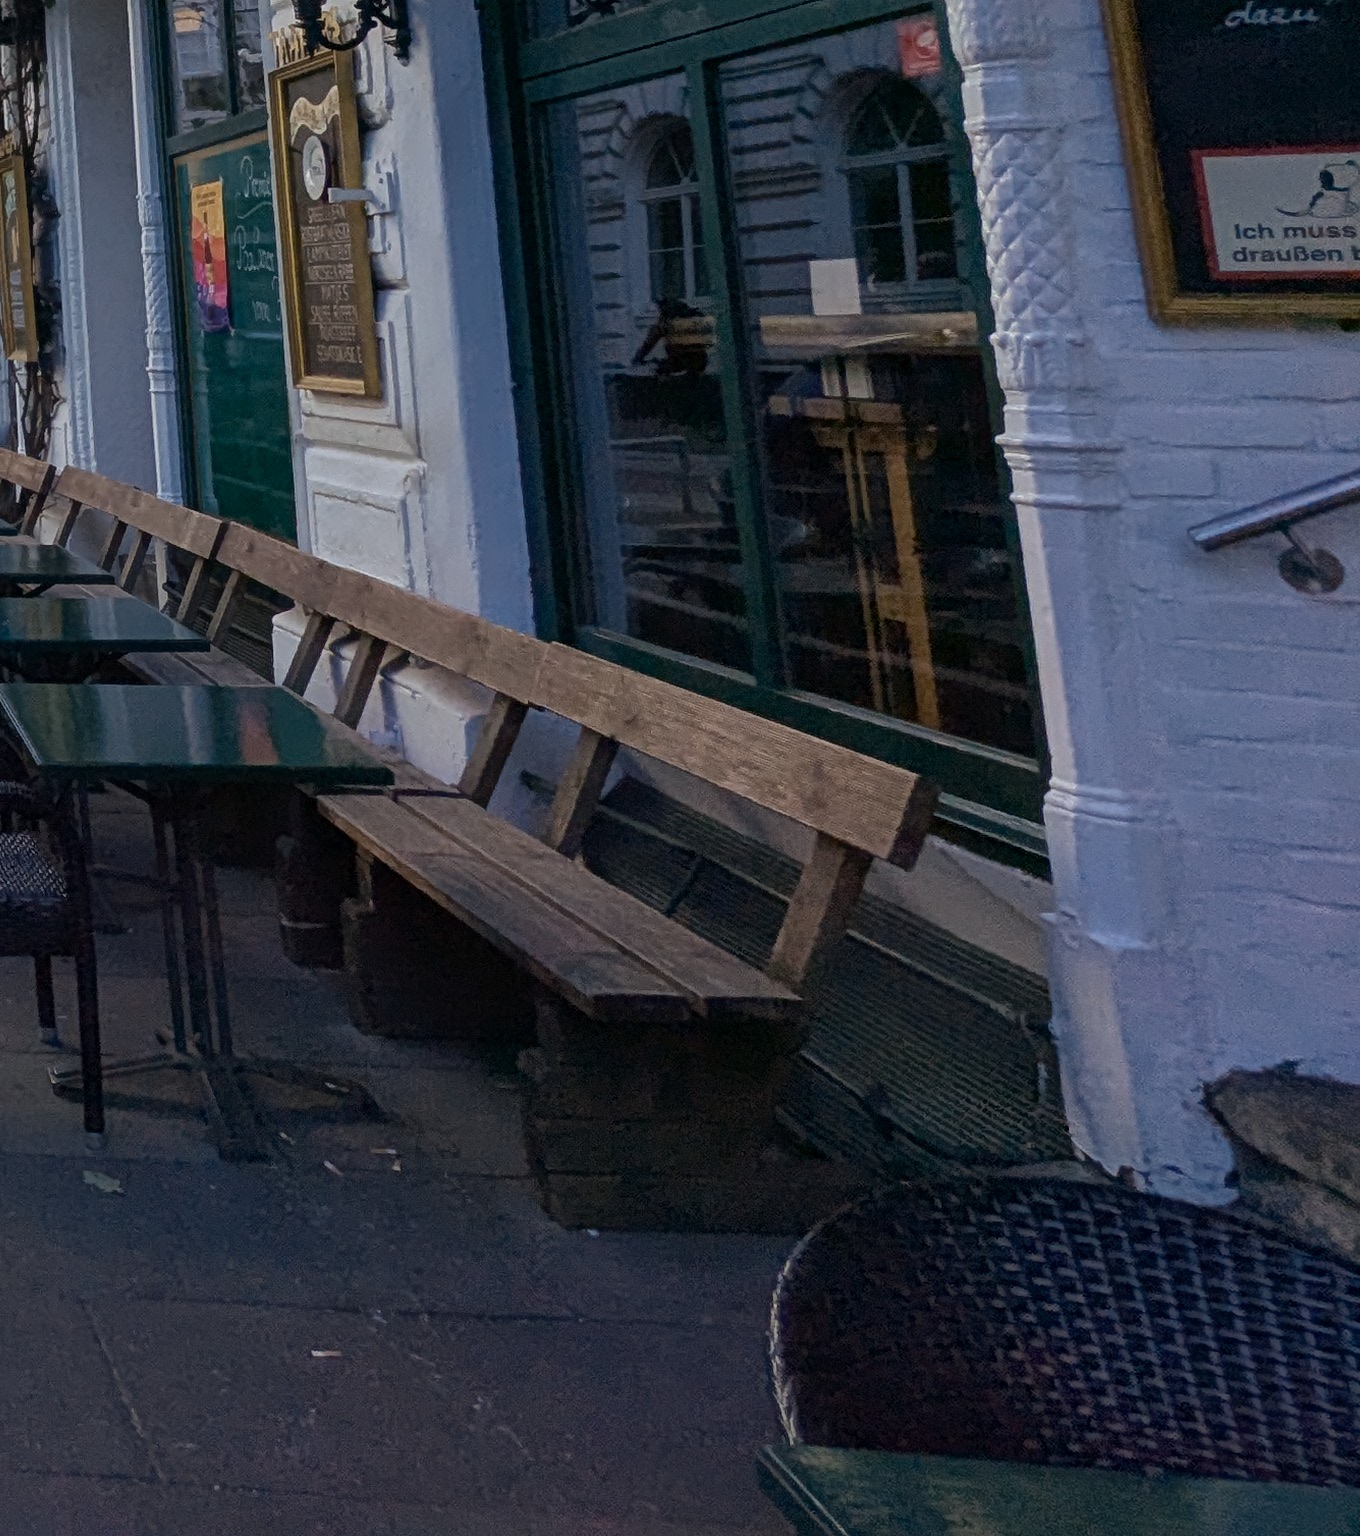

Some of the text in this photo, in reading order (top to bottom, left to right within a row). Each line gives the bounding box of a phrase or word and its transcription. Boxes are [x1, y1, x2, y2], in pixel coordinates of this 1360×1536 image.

[1234, 223, 1357, 239] Ich muss
[1232, 246, 1344, 262] draußen
